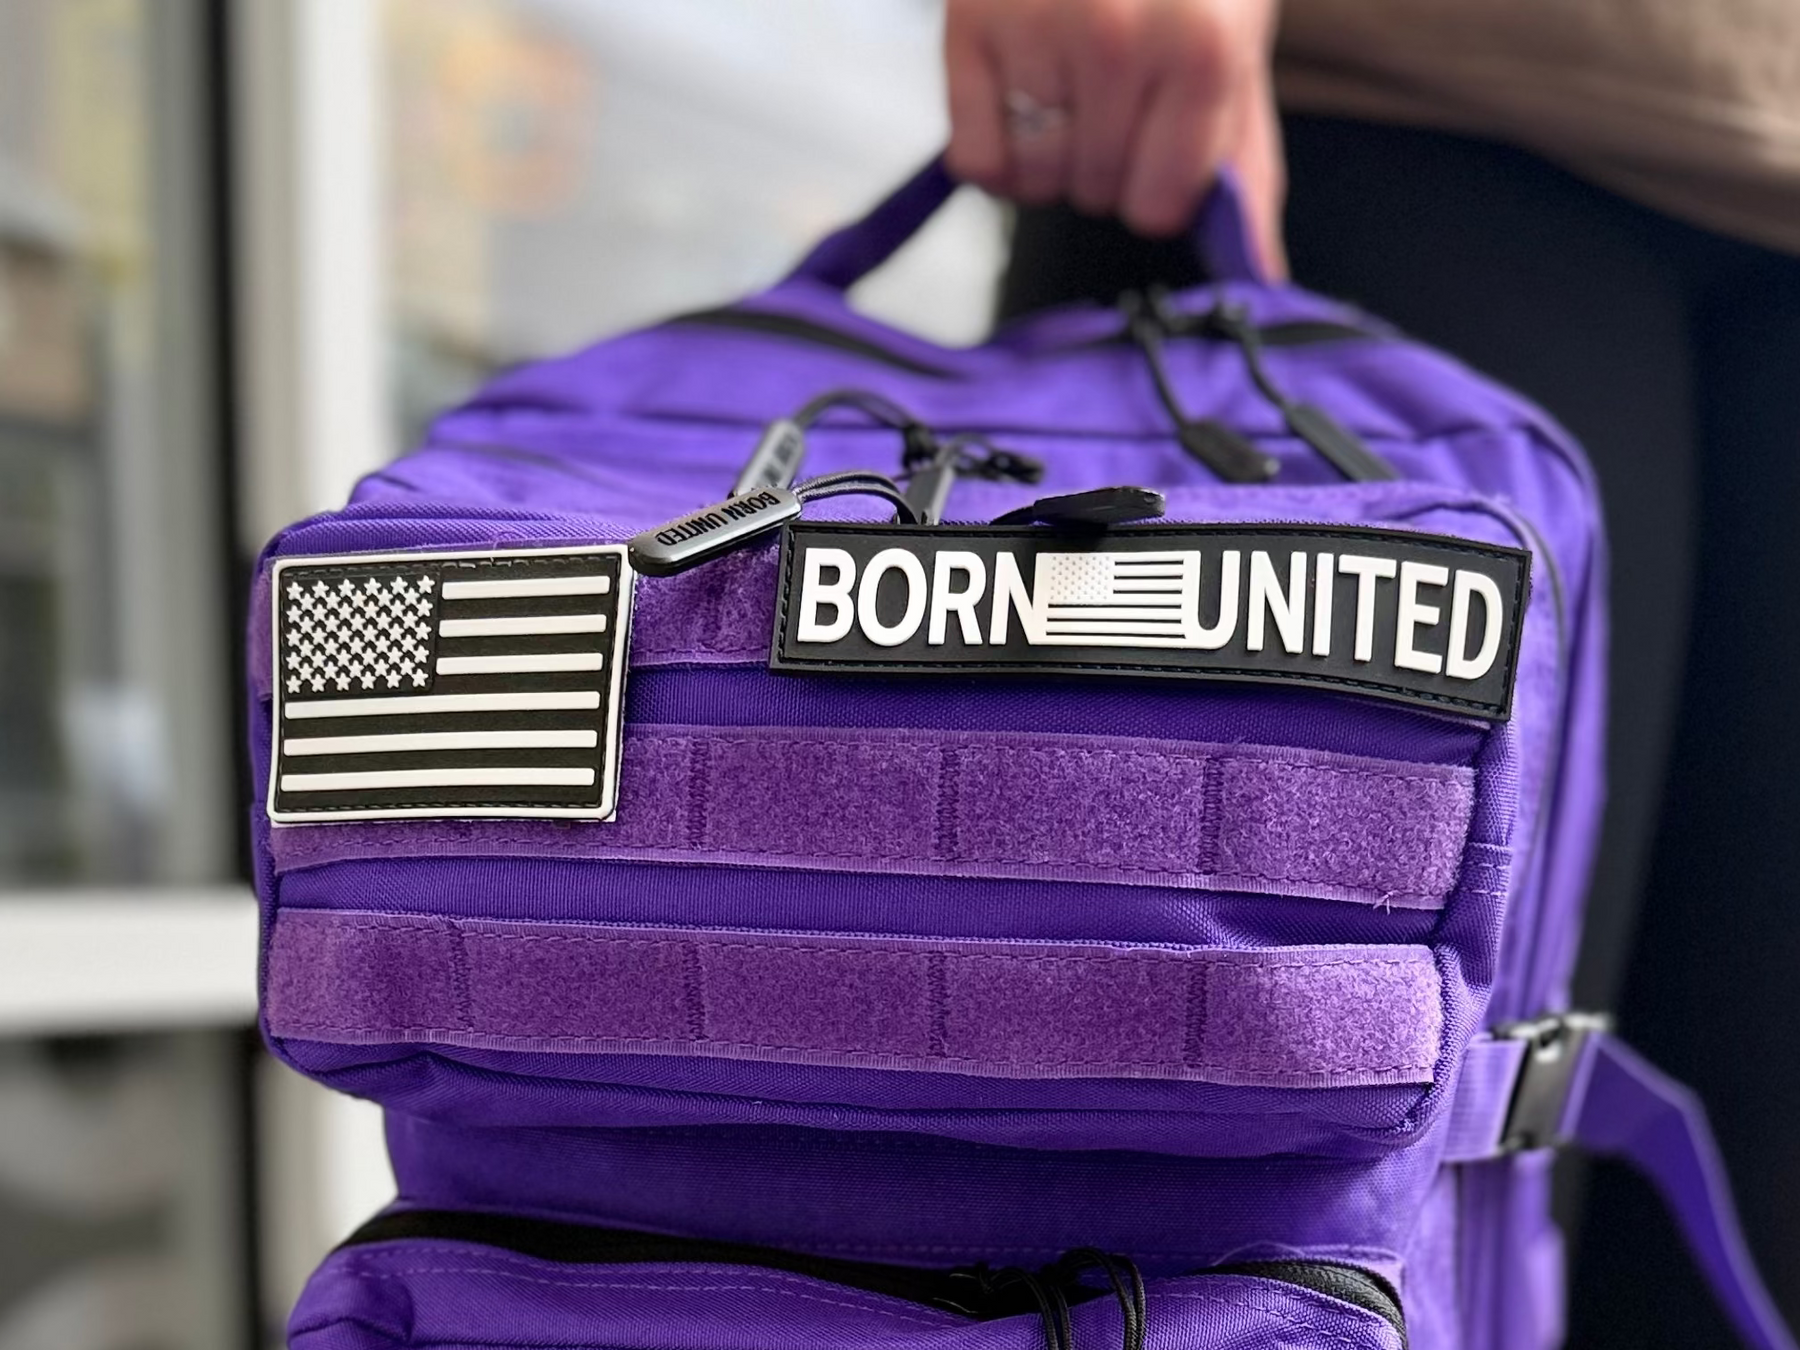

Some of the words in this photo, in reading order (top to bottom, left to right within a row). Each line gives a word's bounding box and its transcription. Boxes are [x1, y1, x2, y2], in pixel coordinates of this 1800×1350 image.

[721, 491, 781, 521] BORN
[655, 512, 728, 547] UNITED
[797, 547, 1046, 646] BORN
[1181, 549, 1503, 681] UNITED
